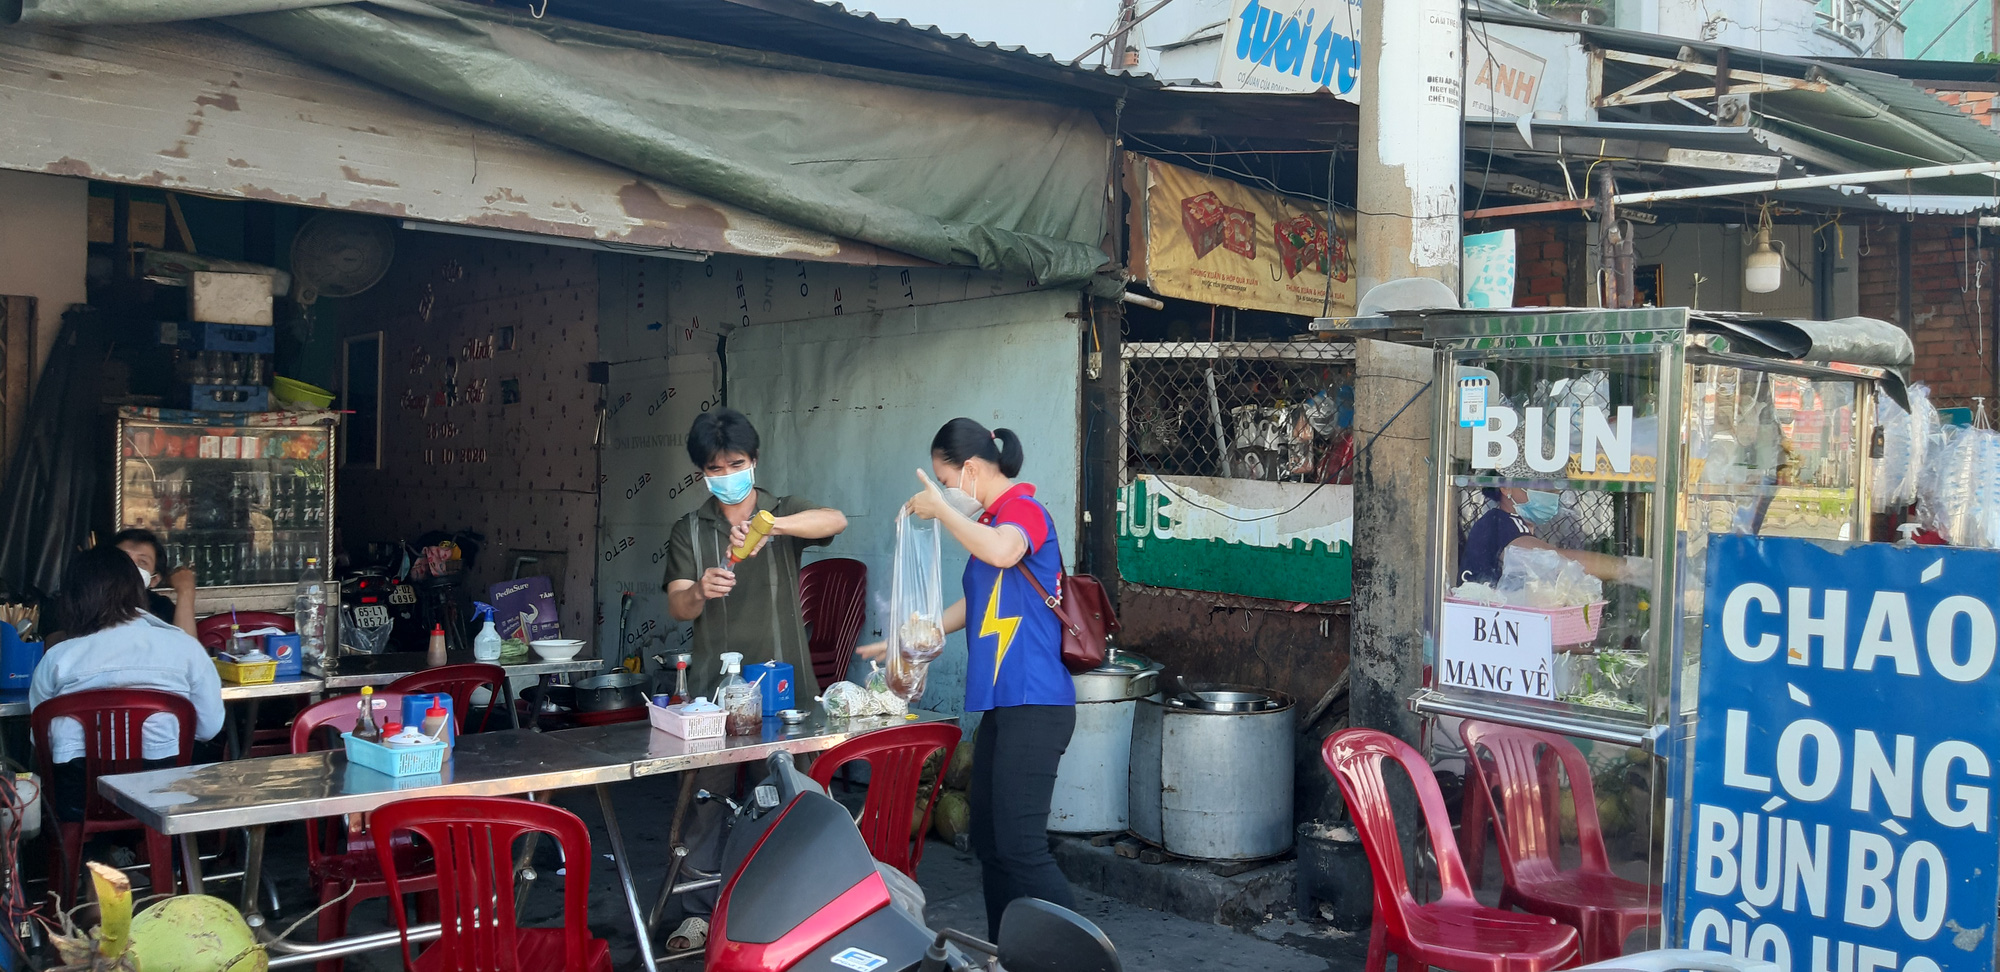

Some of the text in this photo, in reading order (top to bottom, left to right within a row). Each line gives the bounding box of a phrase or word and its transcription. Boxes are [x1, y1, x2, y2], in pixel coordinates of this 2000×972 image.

[1474, 57, 1536, 104] ANH
[1471, 378, 1633, 473] BÚN
[1473, 611, 1520, 647] BÁN
[1722, 558, 1996, 682] CHÁO
[1444, 657, 1550, 698] MANG VỀ
[1723, 682, 1990, 832] LÒNG
[1695, 796, 1947, 940] BÚN BÒ
